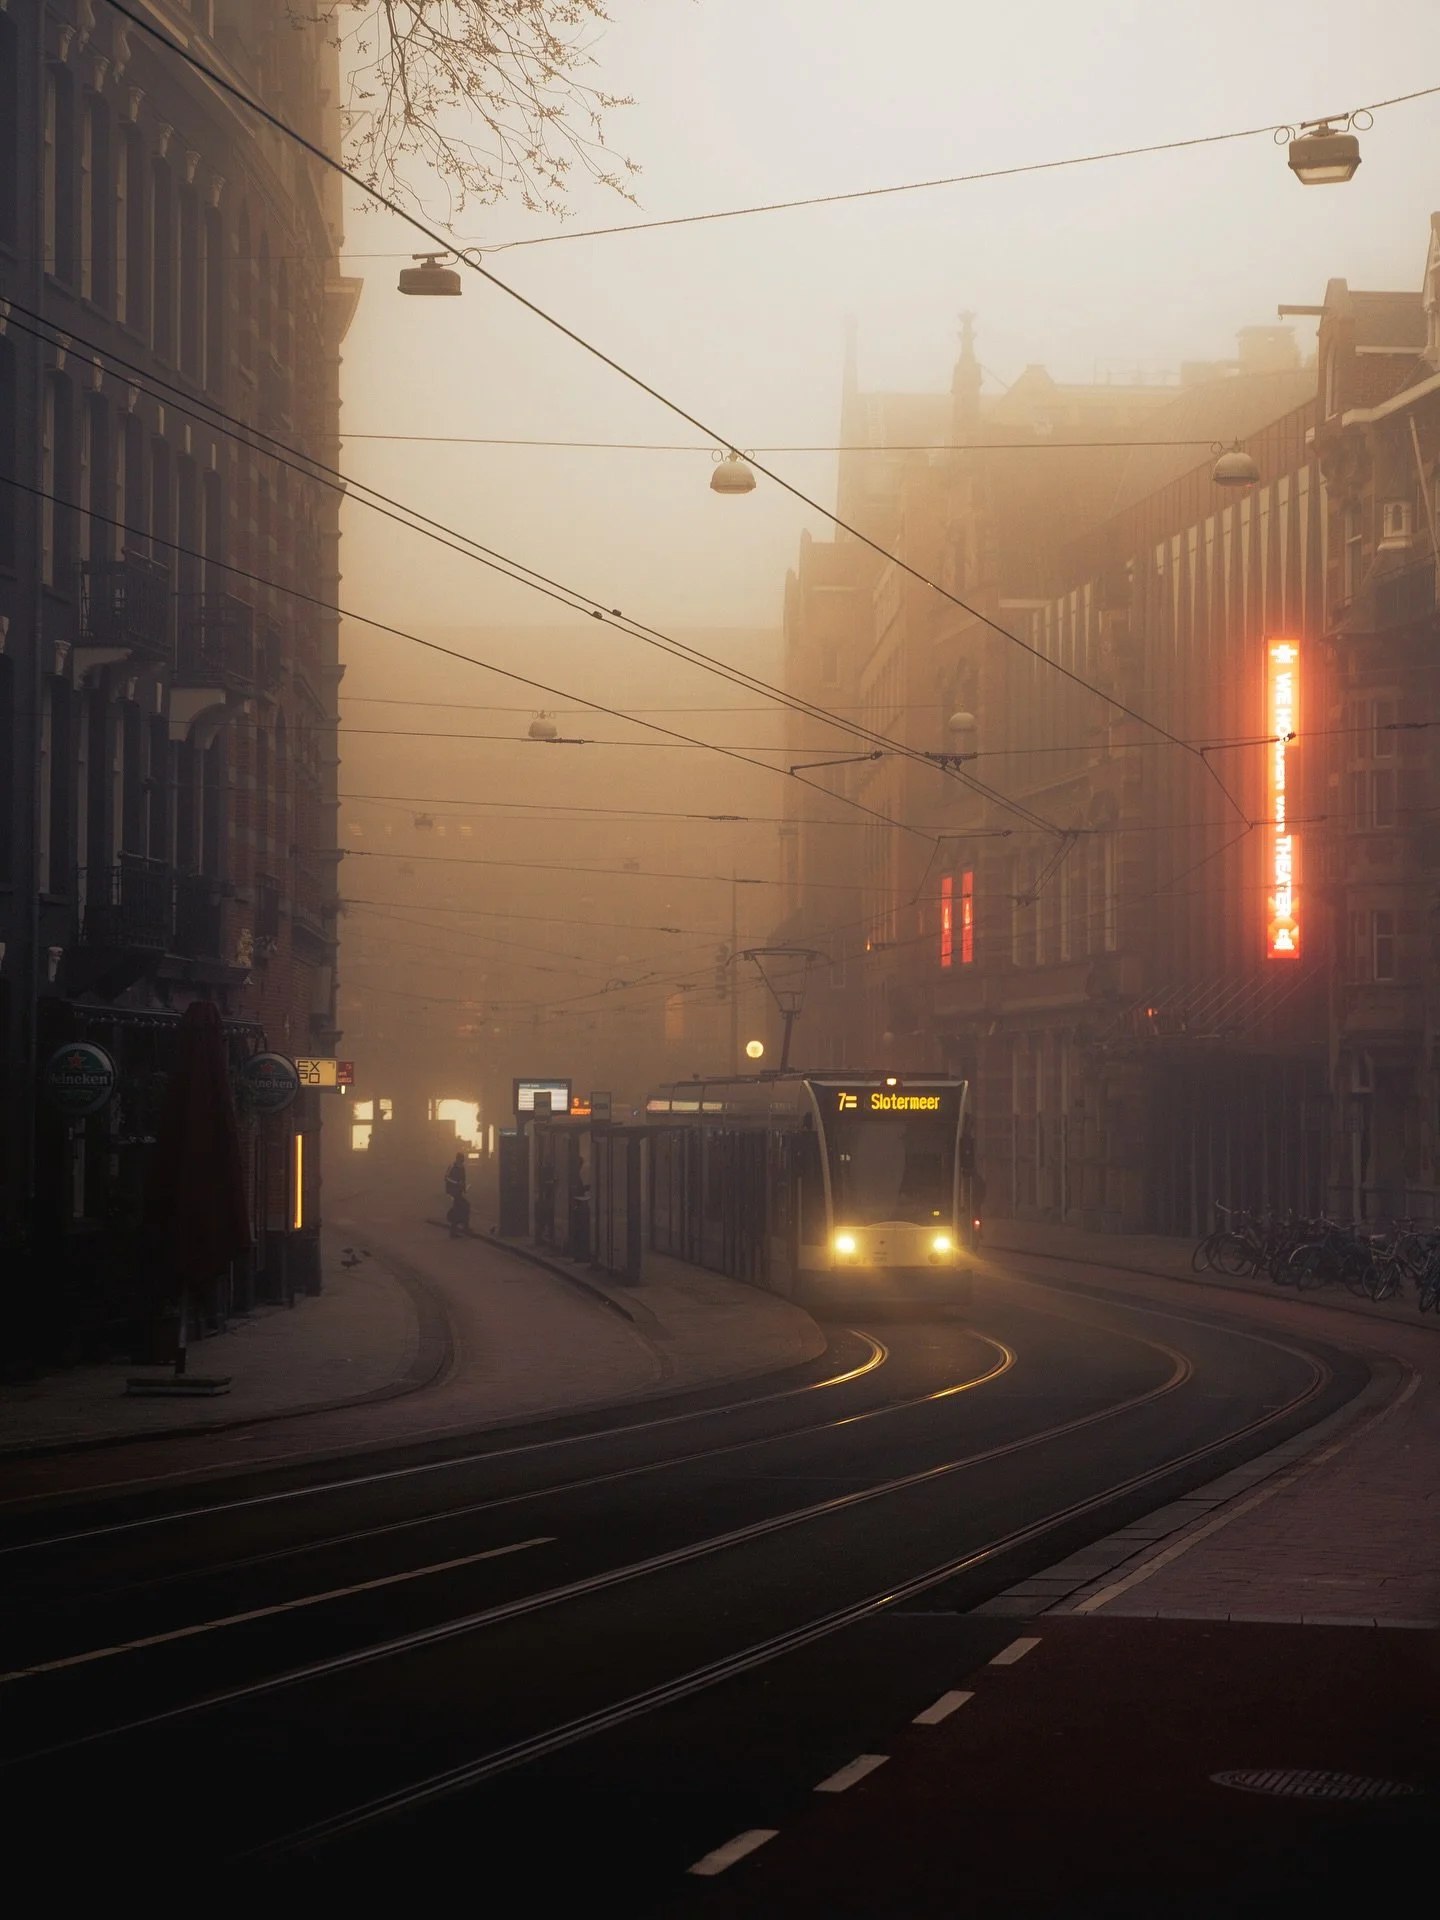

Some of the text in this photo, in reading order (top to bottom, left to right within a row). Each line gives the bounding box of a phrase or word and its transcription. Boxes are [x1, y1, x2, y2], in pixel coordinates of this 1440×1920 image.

[1276, 835, 1291, 916] THEATER
[49, 1072, 108, 1085] Heineken
[252, 1077, 293, 1088] ineken
[871, 1093, 940, 1110] Slotermeer
